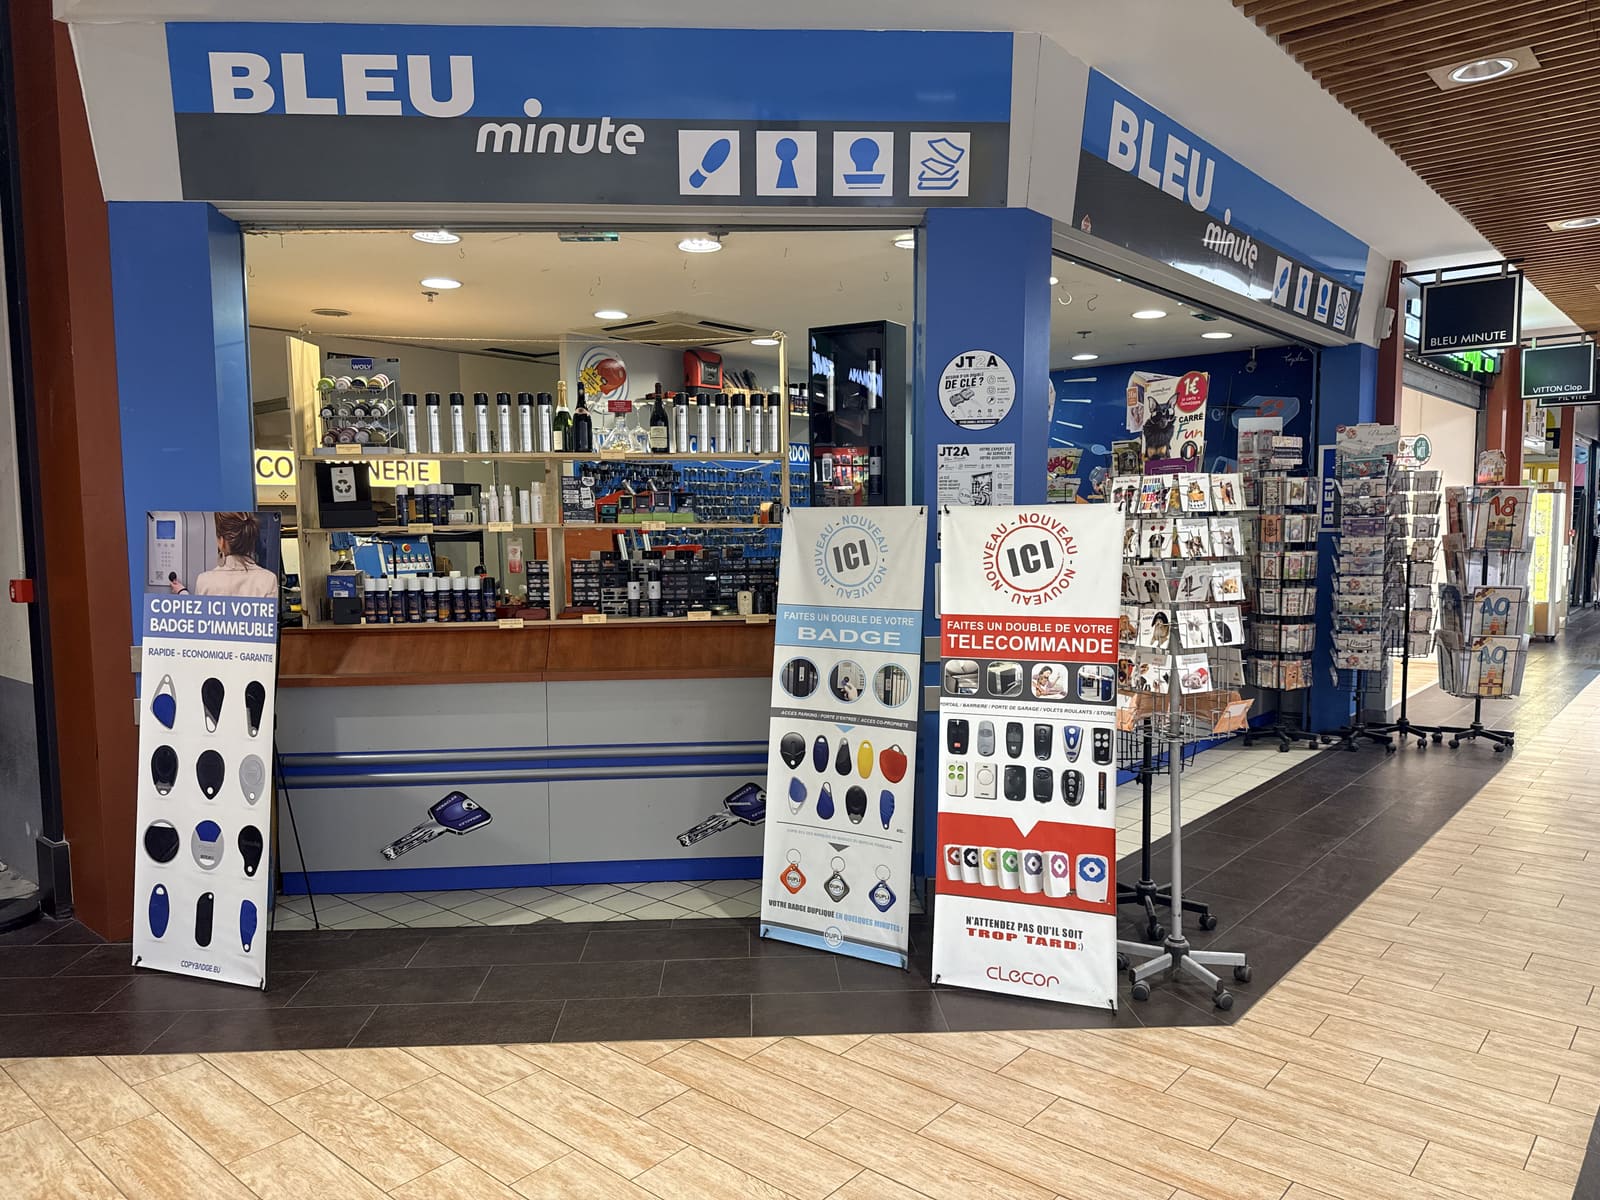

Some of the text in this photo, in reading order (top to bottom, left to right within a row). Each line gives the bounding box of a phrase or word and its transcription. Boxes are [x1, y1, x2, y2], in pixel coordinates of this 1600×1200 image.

[208, 51, 475, 118] BLEU
[476, 98, 645, 155] minute
[1107, 100, 1215, 212] BLEU
[1203, 208, 1258, 270] minute
[1430, 330, 1507, 347] BLEU MINUTE
[955, 355, 998, 368] JT2A
[945, 380, 958, 389] DE
[1184, 376, 1199, 395] 1€
[1532, 383, 1583, 394] VITTON Clop
[1177, 422, 1203, 440] Fun
[938, 446, 970, 456] JT2A
[1323, 478, 1336, 525] BLEU
[1490, 496, 1516, 517] 18
[1018, 513, 1078, 555] NOUVEAU
[815, 514, 889, 600] NOUVEAU NOUVEAU NOUVEAU
[832, 539, 870, 574] ICI
[983, 523, 1008, 591] NOUVEAU
[1006, 539, 1054, 577] ICI
[1011, 568, 1076, 606] NOUVEAU
[150, 599, 274, 618] COPIEZ ICI VOTRE
[150, 618, 274, 638] BADGE D'IMMEUBLE
[784, 612, 914, 626] FAITES UN DOUBLE DE VOTRE
[947, 621, 1113, 634] FAITES UN DOUBLE DE VOTRE
[797, 627, 901, 646] BADGE
[947, 634, 1113, 654] TELECOMMANDE
[148, 648, 175, 657] RAPIDE
[182, 650, 233, 660] ECONOMIQUE
[240, 652, 273, 663] GARANTIE
[768, 899, 787, 909] VOTRE
[788, 903, 806, 913] BADGE
[836, 912, 843, 920] EN
[844, 914, 873, 926] QUELQUES
[874, 919, 900, 932] MINUTES
[825, 930, 843, 940] DUPLI
[966, 916, 1083, 940] N'ATTENDEZ PAS QU'IL SOIT
[966, 928, 1018, 942] TROP
[181, 960, 221, 974] COPYBADGE.EU
